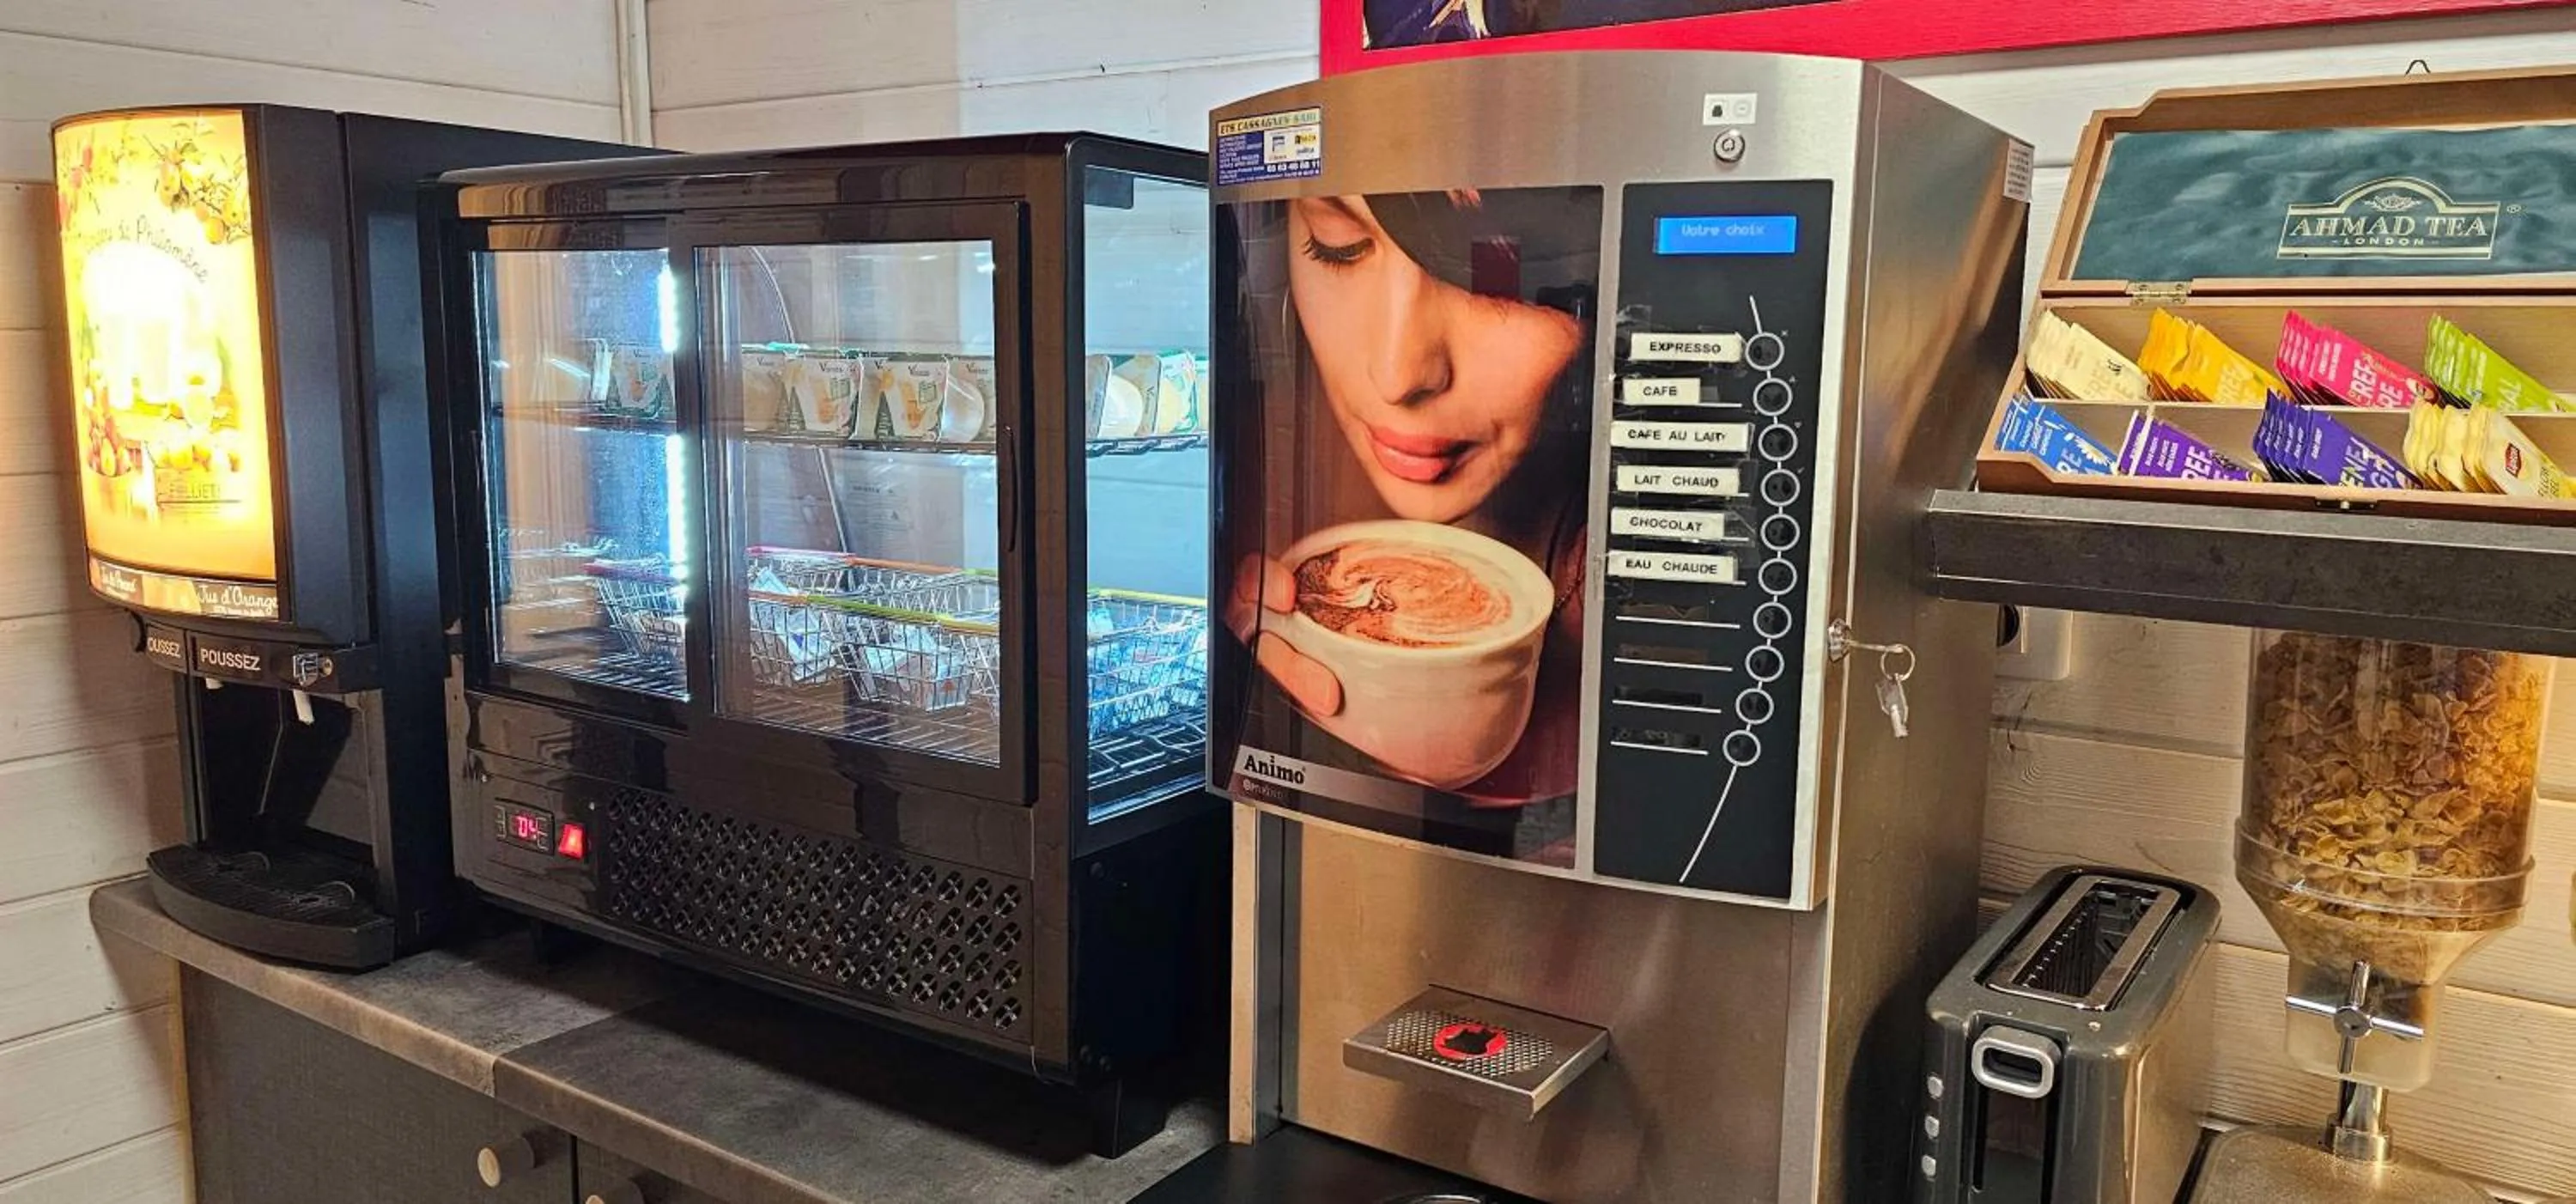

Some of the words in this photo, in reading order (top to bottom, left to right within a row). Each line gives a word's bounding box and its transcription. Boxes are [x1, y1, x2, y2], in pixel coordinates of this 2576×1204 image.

[1681, 222, 1720, 236] Votre
[1725, 222, 1765, 236] choix
[2289, 216, 2415, 236] AHMAD
[2423, 216, 2488, 236] TEA
[2343, 237, 2424, 246] LONDON
[1649, 342, 1722, 354] EXPRESSO
[1643, 386, 1678, 396] CAFE
[1627, 429, 1662, 441] CAFE
[1668, 430, 1687, 441] AU
[1694, 432, 1725, 442] LAIT
[1634, 475, 1662, 485] LAIT
[1672, 476, 1719, 489] CHAUD
[1630, 516, 1703, 532] CHOCOLAT
[1625, 558, 1651, 569] EAU
[1662, 561, 1717, 575] CHAUDE
[196, 585, 219, 604] Jus
[147, 637, 181, 659] OUSSEZ
[200, 648, 261, 671] POUSSEZ
[1244, 754, 1305, 785] Animo
